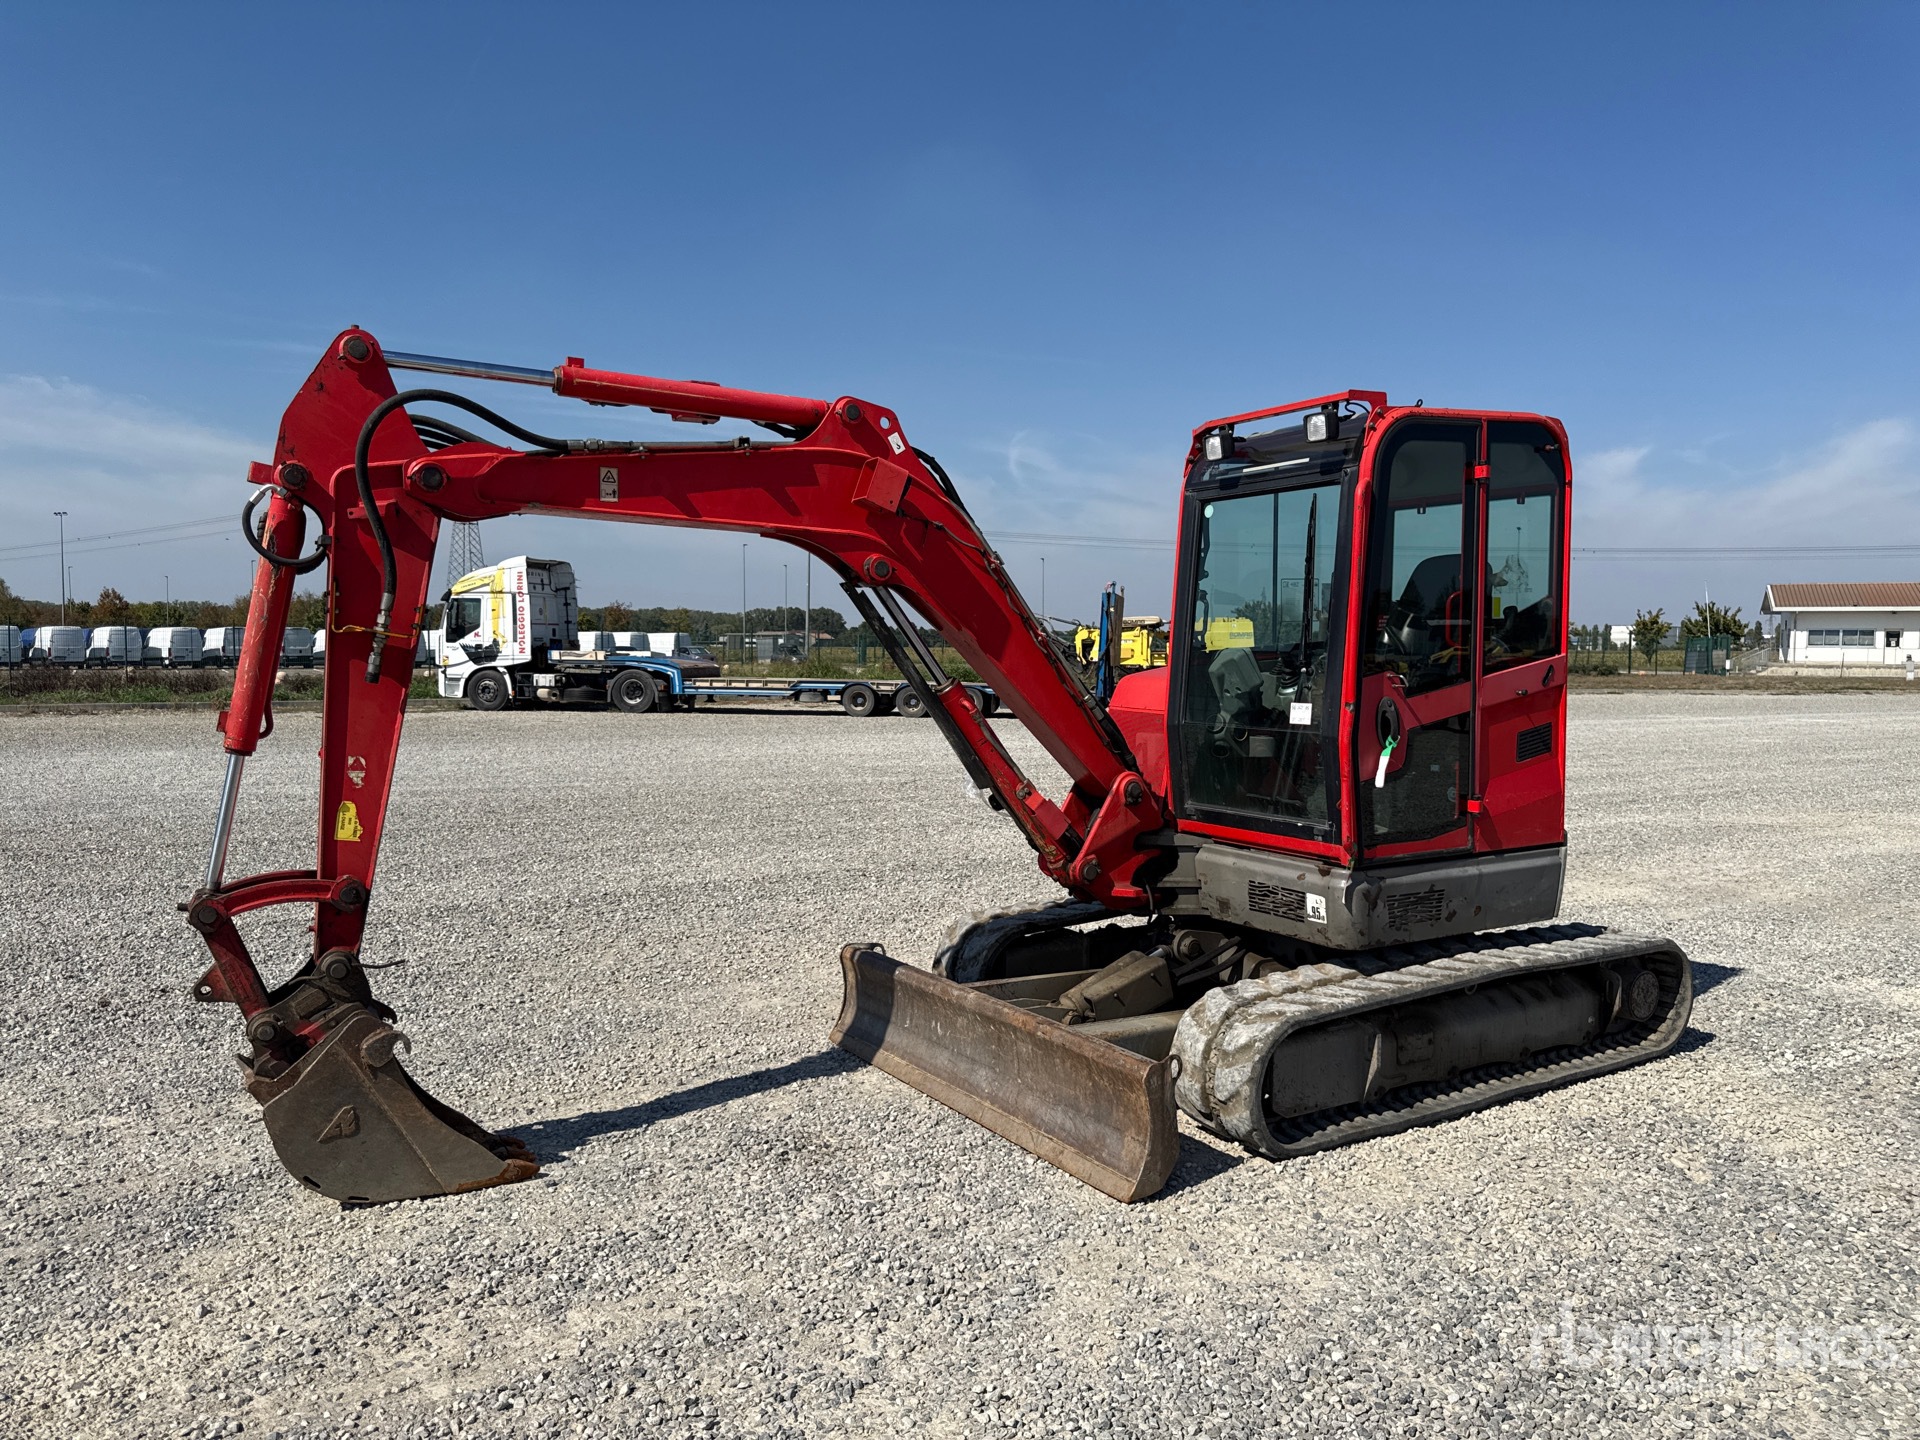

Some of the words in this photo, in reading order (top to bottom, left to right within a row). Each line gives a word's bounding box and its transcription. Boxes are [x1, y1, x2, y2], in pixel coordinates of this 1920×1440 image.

[517, 571, 525, 603] LORINI
[518, 606, 526, 655] NOLEGGIO
[1311, 906, 1321, 920] 95
